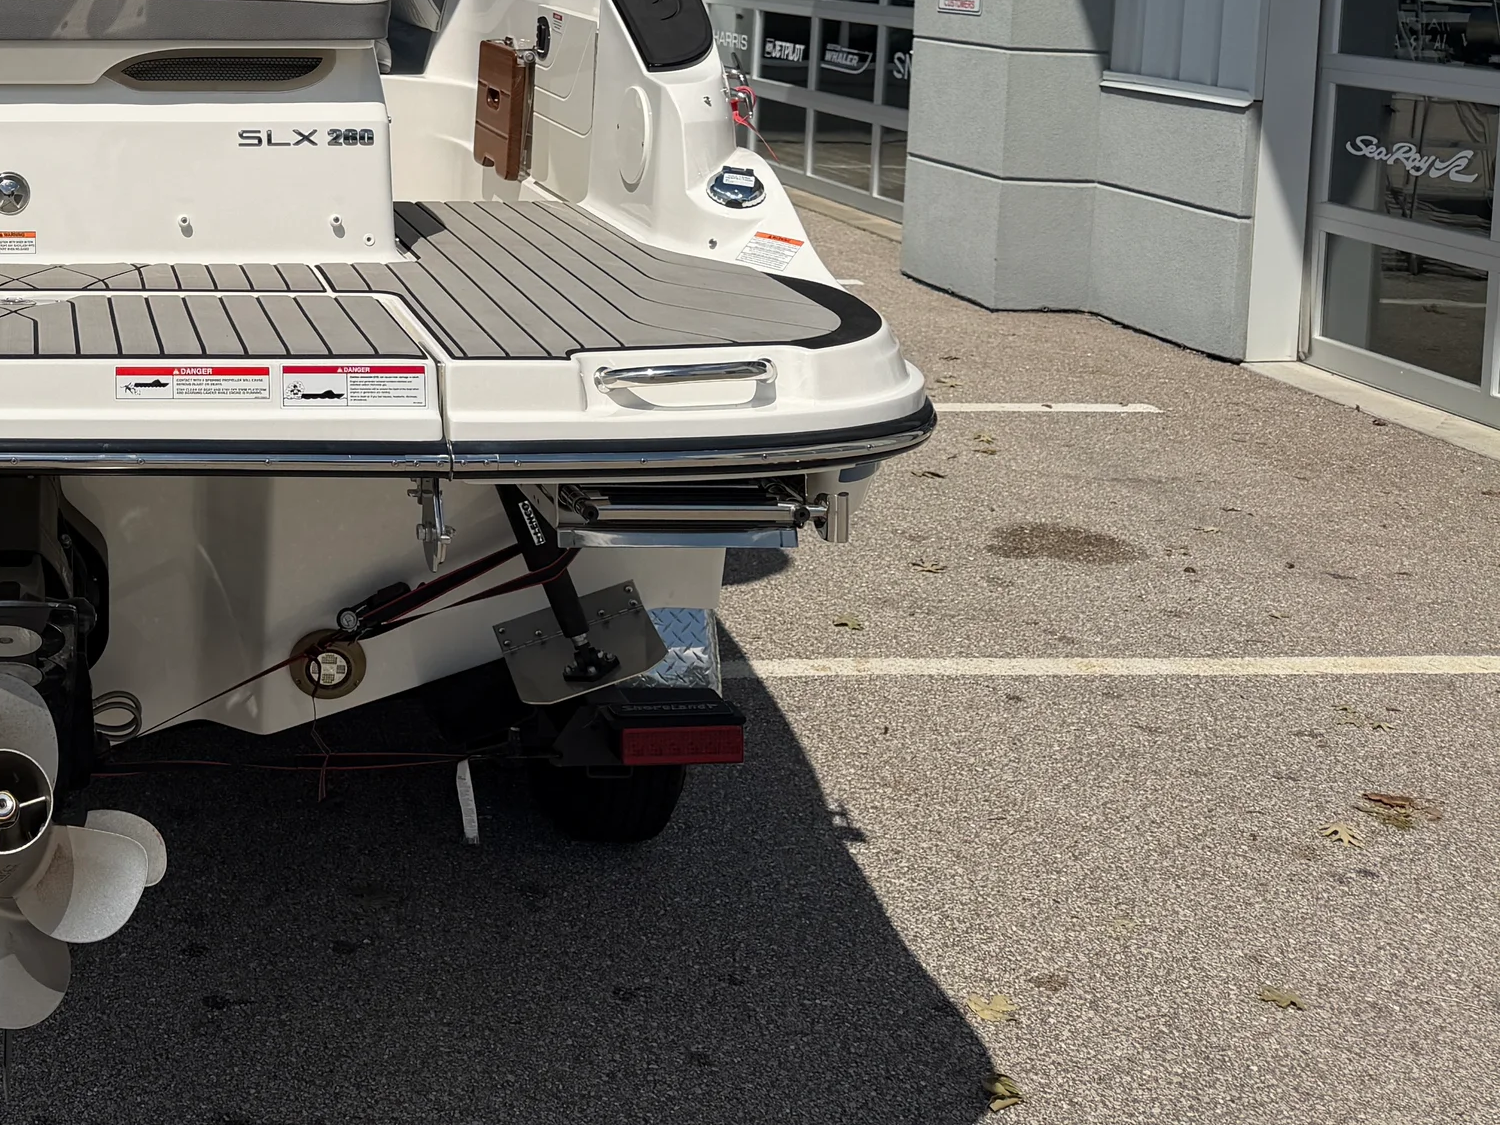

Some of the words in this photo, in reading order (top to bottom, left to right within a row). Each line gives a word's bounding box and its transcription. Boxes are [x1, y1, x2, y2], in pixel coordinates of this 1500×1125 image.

[825, 50, 860, 67] WHALER
[238, 129, 318, 147] SLX
[1345, 135, 1391, 160] Sea
[1387, 142, 1436, 176] Ray
